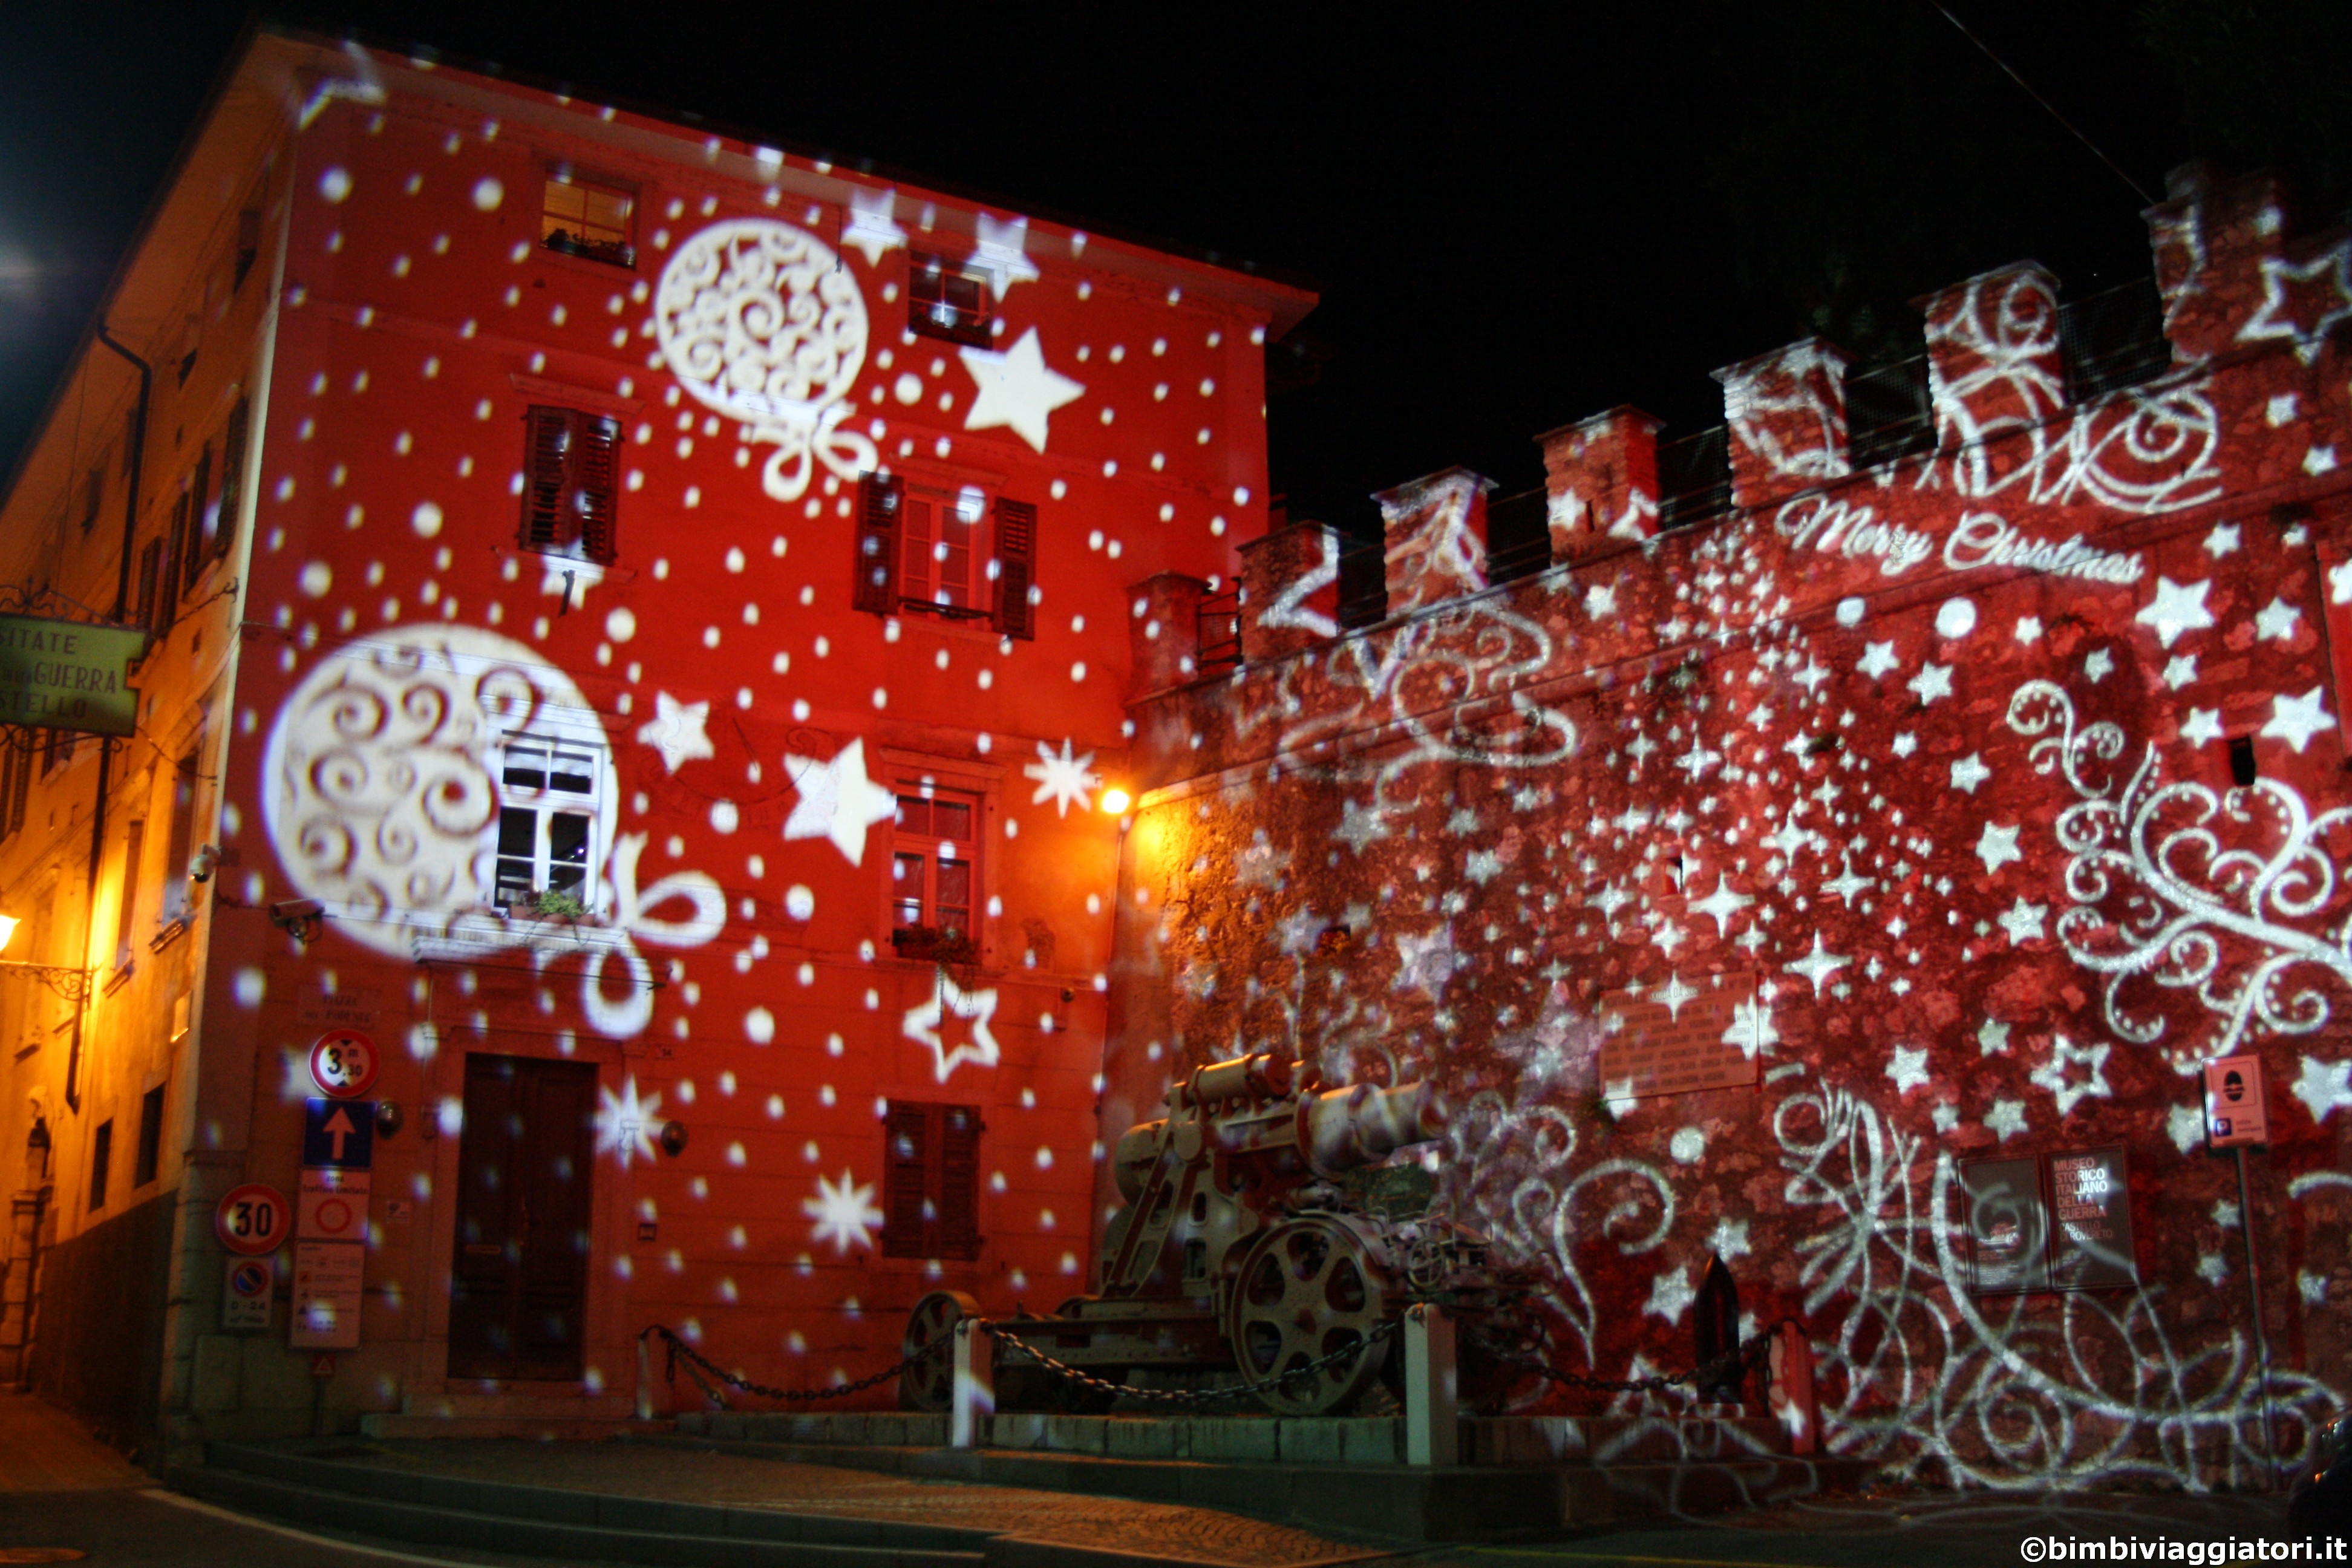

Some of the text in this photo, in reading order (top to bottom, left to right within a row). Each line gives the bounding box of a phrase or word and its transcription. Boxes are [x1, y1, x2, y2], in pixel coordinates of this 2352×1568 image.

[1774, 490, 2145, 584] Merry Christmas
[33, 662, 117, 694] GUERRA
[2054, 1157, 2094, 1171] MUSEO
[2055, 1168, 2106, 1183] STORICO
[2056, 1180, 2108, 1196] ITALIANO
[2057, 1194, 2094, 1208] DELLA
[235, 1201, 272, 1236] 30
[2059, 1205, 2108, 1220] GUERRA
[2060, 1221, 2102, 1230] CASTELLO
[2069, 1228, 2113, 1241] ROVERETO
